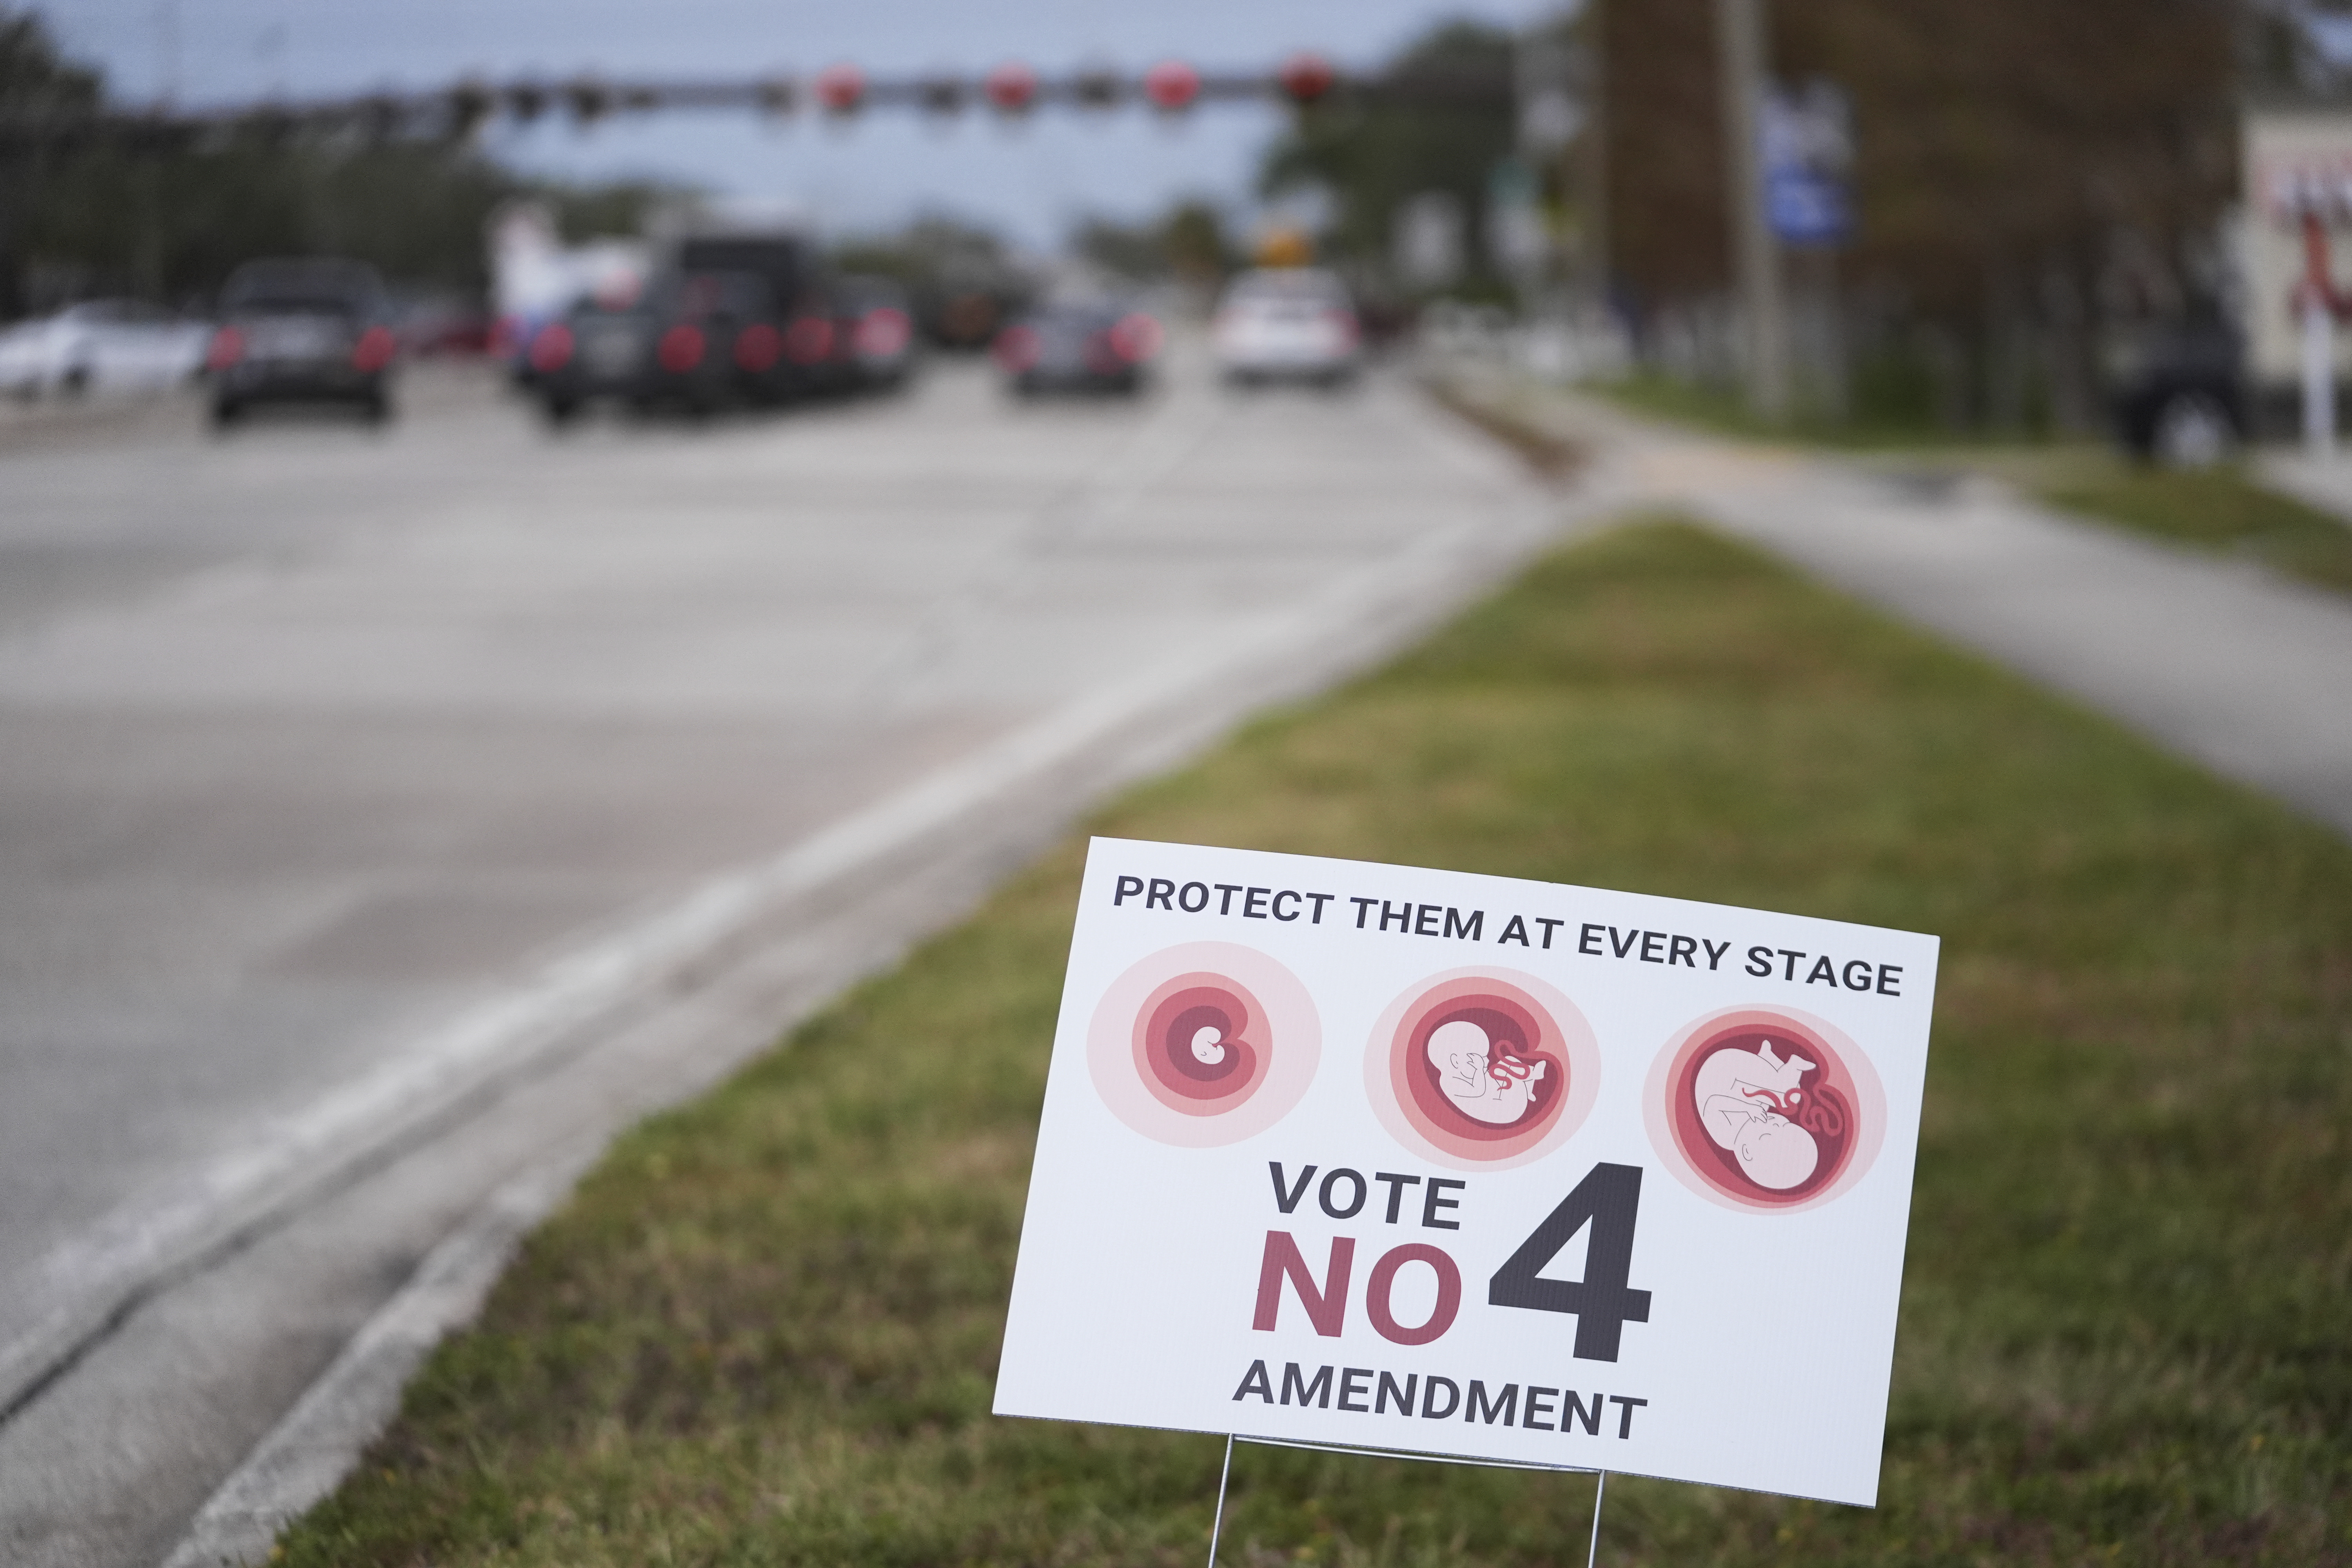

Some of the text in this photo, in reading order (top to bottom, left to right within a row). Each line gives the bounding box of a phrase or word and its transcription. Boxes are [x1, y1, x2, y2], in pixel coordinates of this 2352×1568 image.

[1114, 875, 1903, 997] PROTECT THEM AT EVERY STAGE
[1269, 1161, 1466, 1230] VOTE
[1252, 1230, 1461, 1346] NO
[1488, 1162, 1652, 1363] 4
[1232, 1359, 1648, 1439] AMENDMENT
